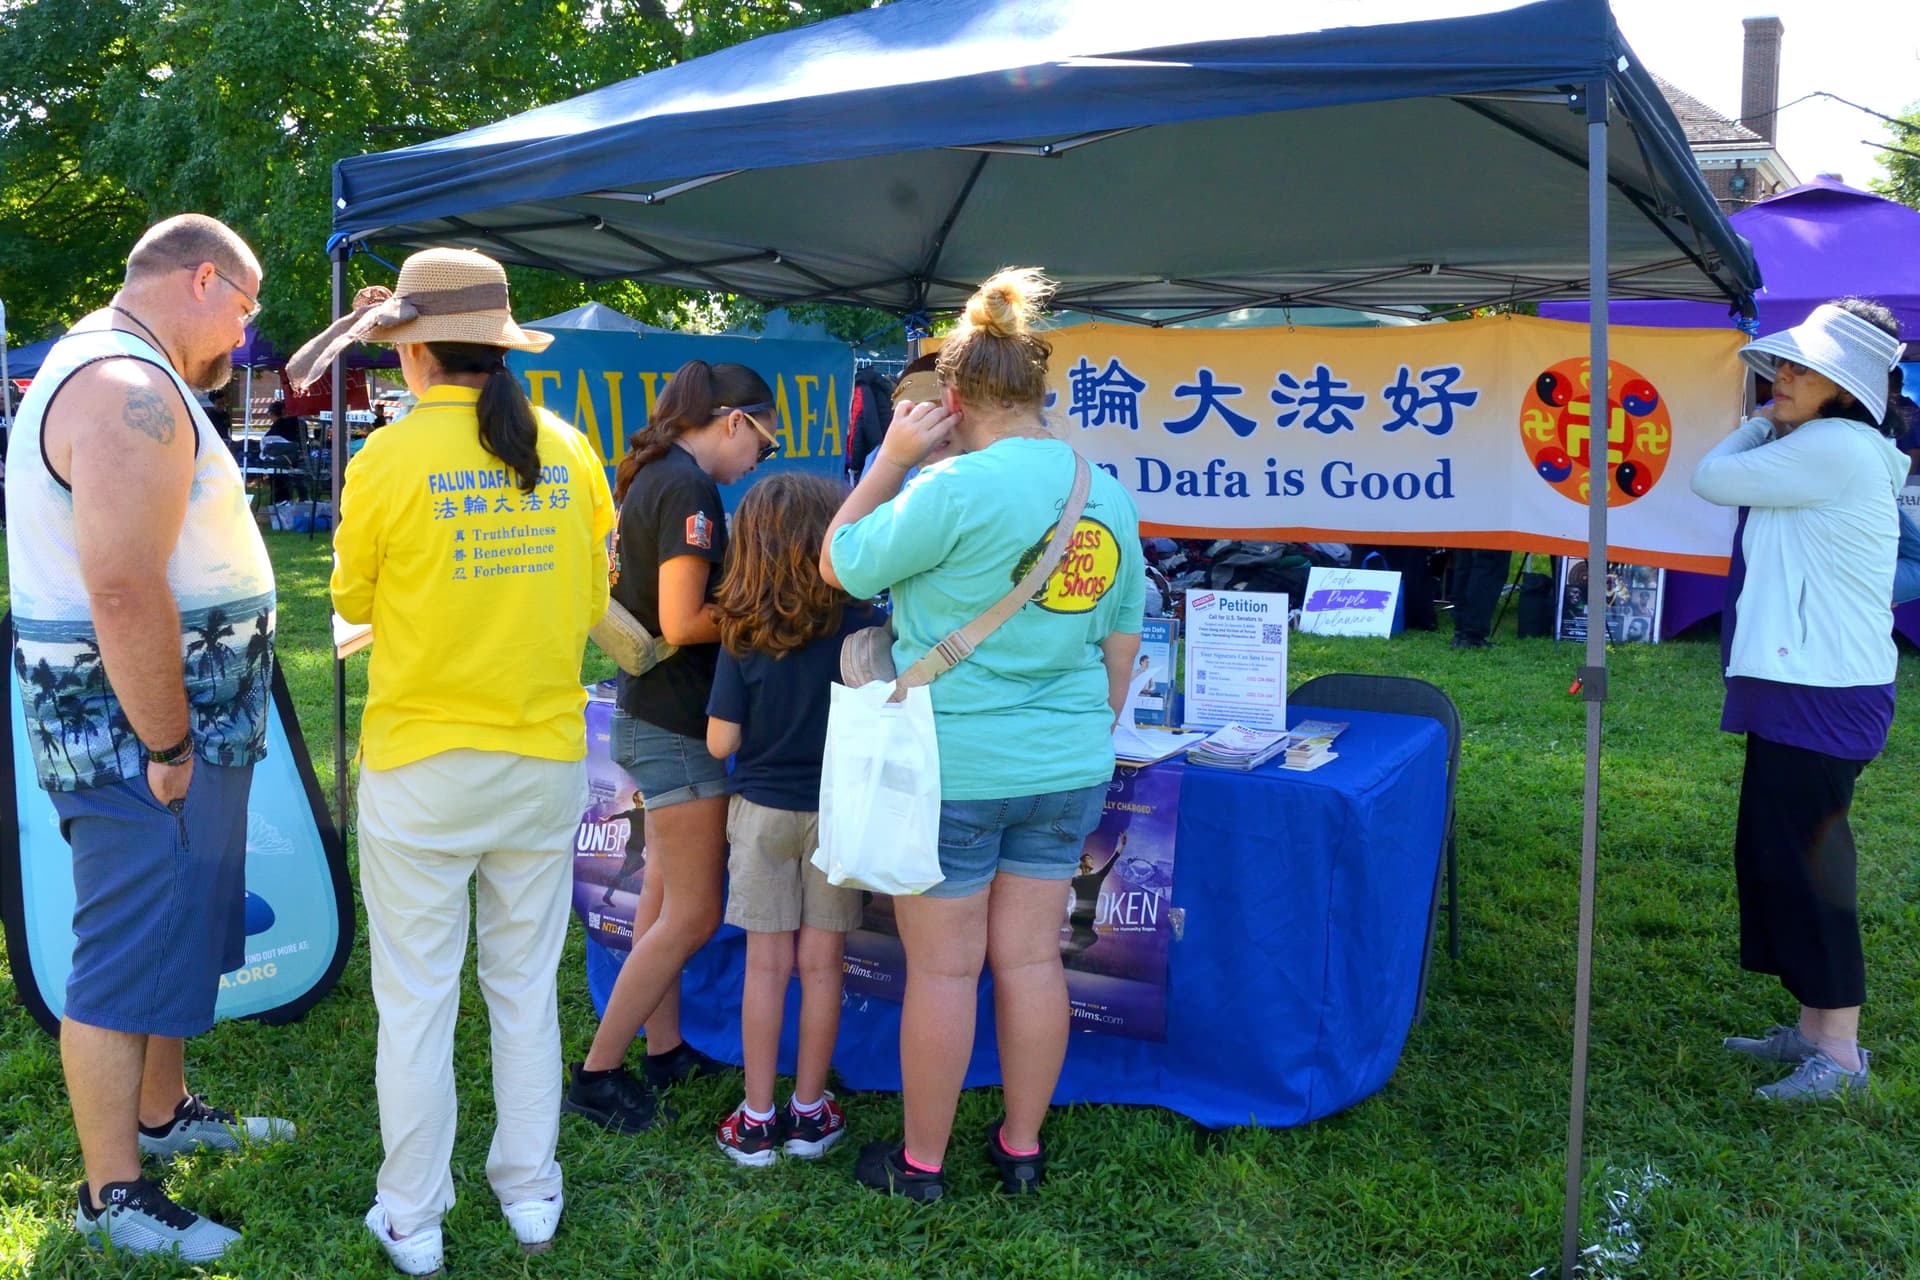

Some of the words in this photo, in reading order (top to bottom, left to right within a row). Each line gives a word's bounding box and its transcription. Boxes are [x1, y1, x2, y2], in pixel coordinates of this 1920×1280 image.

[1043, 357, 1479, 437] 輪大法好
[773, 372, 843, 459] AFA
[429, 470, 476, 494] FALUN
[479, 469, 512, 489] DAFA
[536, 465, 569, 486] OOD
[1135, 456, 1250, 498] Dafa
[1265, 457, 1305, 497] is
[1320, 458, 1456, 500] Good
[433, 488, 571, 520] 法輪大法好
[472, 525, 556, 541] Truthfulness
[473, 544, 554, 560] Benevolence
[1061, 549, 1094, 574] Pro
[473, 561, 554, 578] Forbearance
[1058, 572, 1107, 601] Shops
[1219, 597, 1269, 613] Petition
[1326, 590, 1369, 607] Purple
[262, 949, 277, 961] OUT
[111, 1188, 127, 1201] 01
